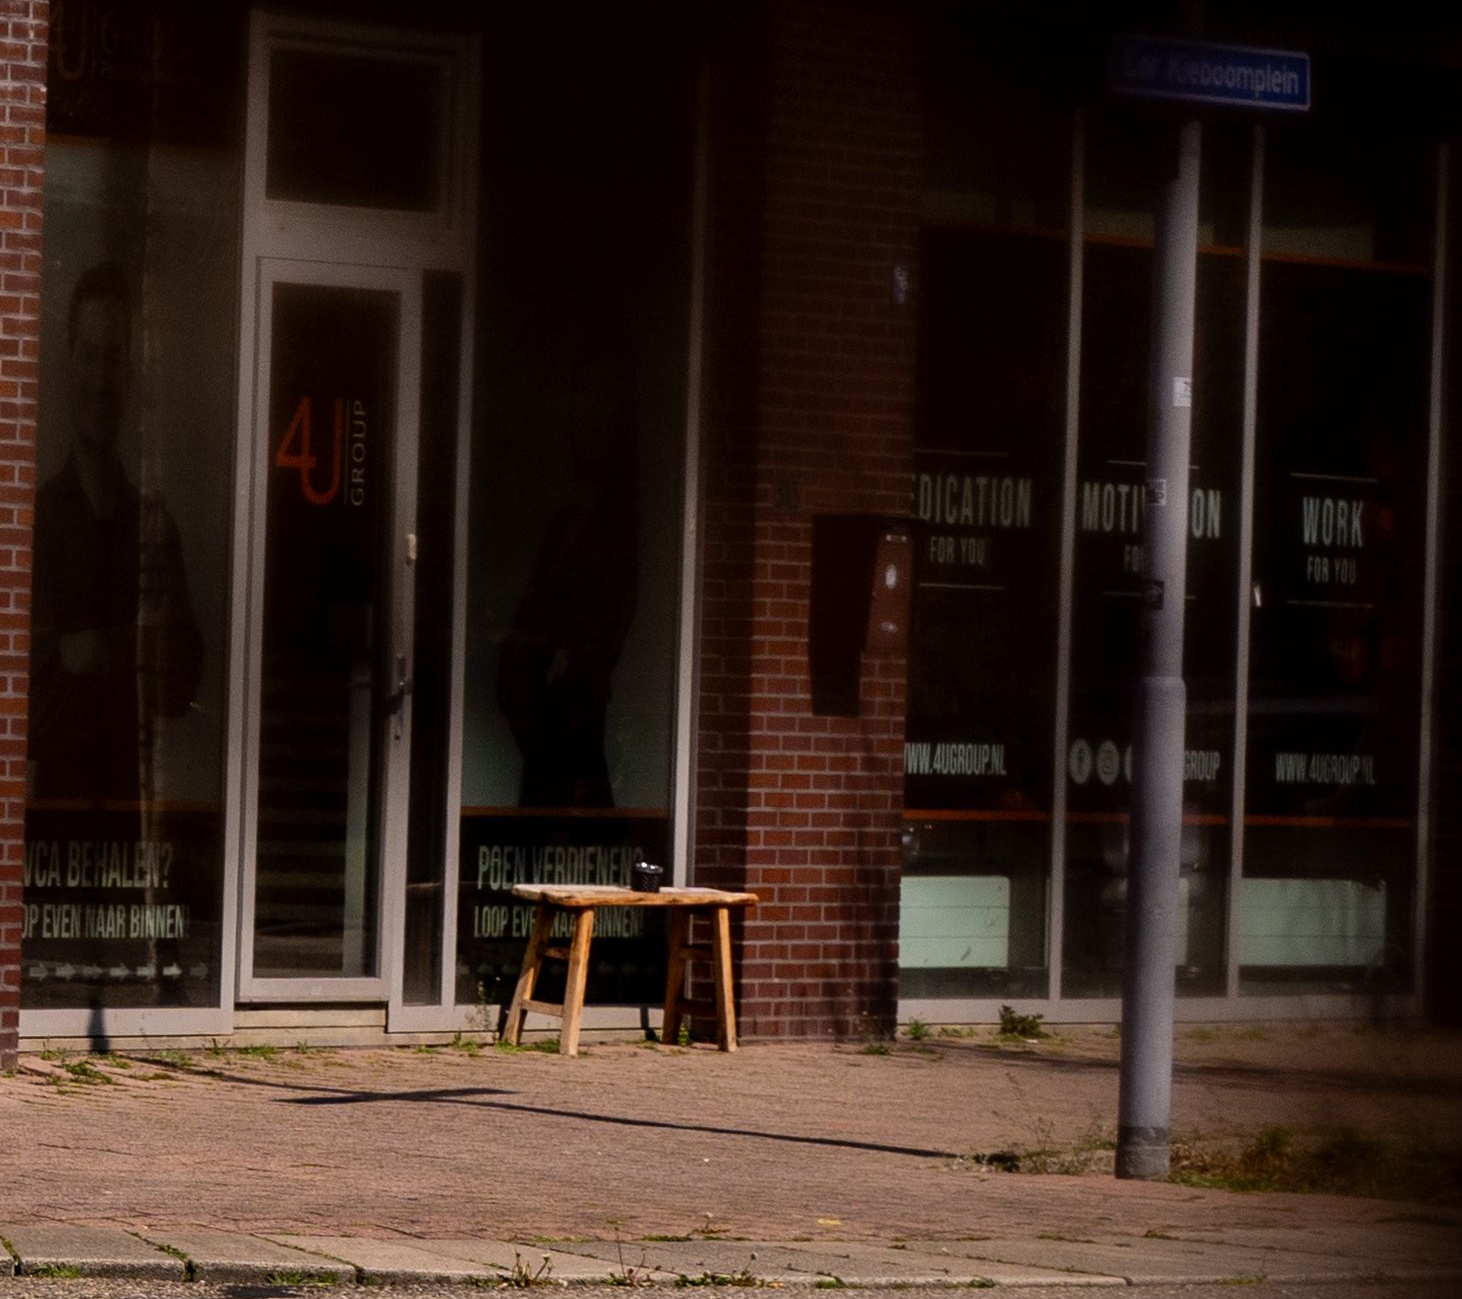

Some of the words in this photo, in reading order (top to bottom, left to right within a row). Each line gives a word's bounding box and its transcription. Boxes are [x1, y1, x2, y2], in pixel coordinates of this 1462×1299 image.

[1166, 51, 1300, 98] Kieboomplein
[275, 396, 344, 506] 4U
[350, 399, 368, 507] GROUP
[912, 473, 1032, 528] DICATION
[1082, 481, 1221, 538] MOTION
[1302, 496, 1365, 548] WORK
[929, 535, 956, 564] FOR
[959, 537, 986, 566] YOU
[1306, 554, 1330, 585] FOR
[1333, 556, 1358, 586] YOU
[905, 742, 1008, 776] WW.4UGROUP.NL
[67, 840, 173, 889] BEHALEN?
[477, 845, 526, 891] POEN
[42, 904, 81, 939] EVEN
[85, 904, 126, 939] NAAR
[473, 905, 508, 939] LOOP
[512, 907, 536, 938] EVE
